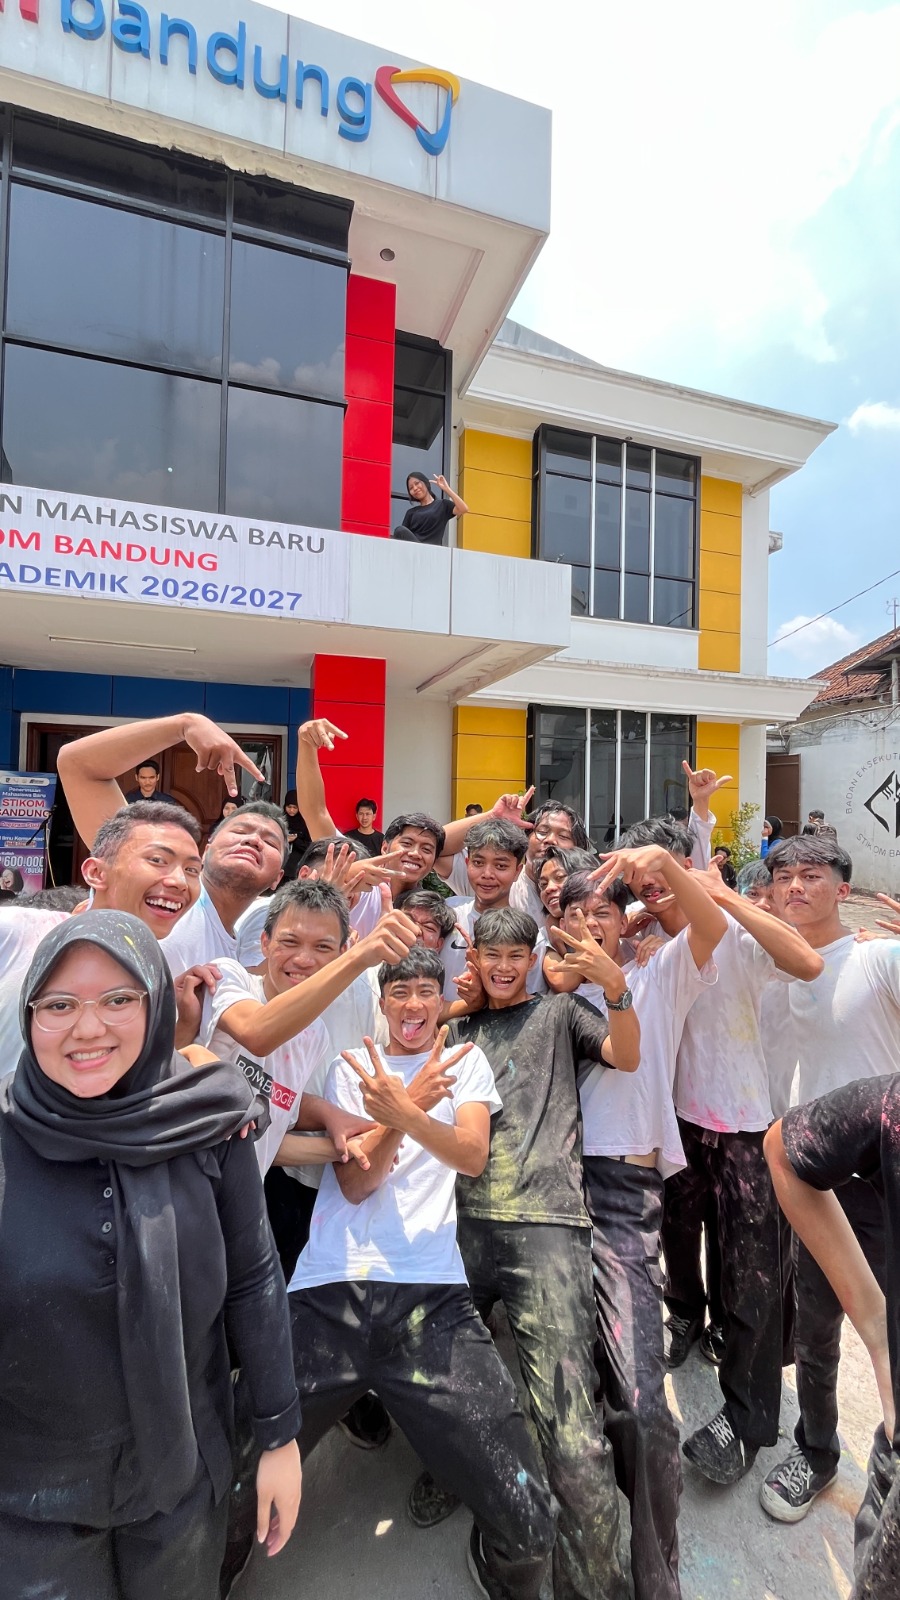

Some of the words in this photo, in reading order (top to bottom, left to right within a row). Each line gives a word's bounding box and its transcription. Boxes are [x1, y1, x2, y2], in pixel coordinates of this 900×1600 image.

[61, 0, 374, 142] bandung
[36, 498, 238, 543] MAHASISWA
[248, 527, 325, 554] BARU
[54, 534, 218, 572] BANDUNG
[0, 562, 128, 594] ADEMIK
[140, 575, 303, 611] 2026/2027
[0, 809, 50, 818] ANDUNG
[2, 799, 45, 808] STIKOM
[845, 778, 858, 815] BADAN
[856, 833, 887, 857] STIKOM
